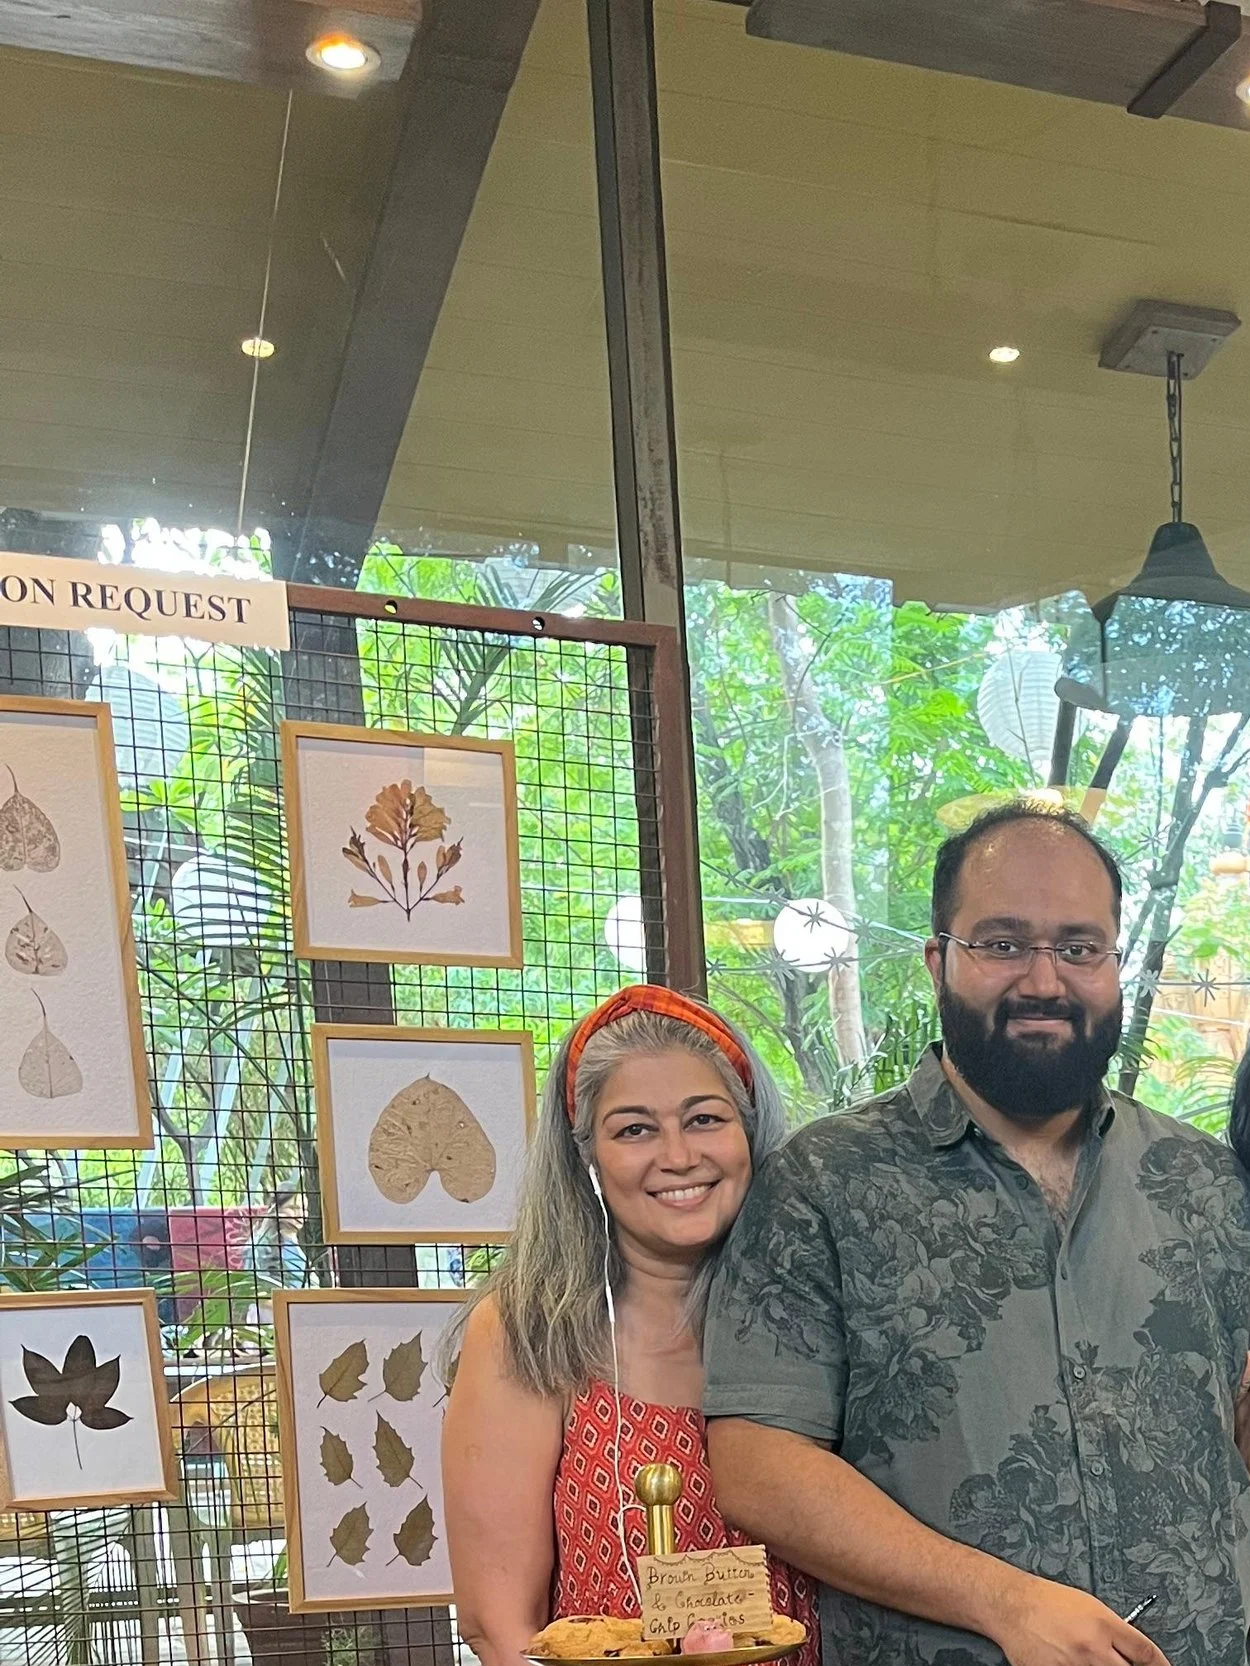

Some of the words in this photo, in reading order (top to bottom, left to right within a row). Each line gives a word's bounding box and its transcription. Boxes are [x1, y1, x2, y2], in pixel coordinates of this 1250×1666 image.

[0, 574, 56, 607] ON
[67, 580, 252, 624] REQUEST
[646, 1566, 697, 1590] Brown
[701, 1561, 755, 1586] Butter
[651, 1592, 666, 1612] &
[649, 1616, 680, 1635] Chip
